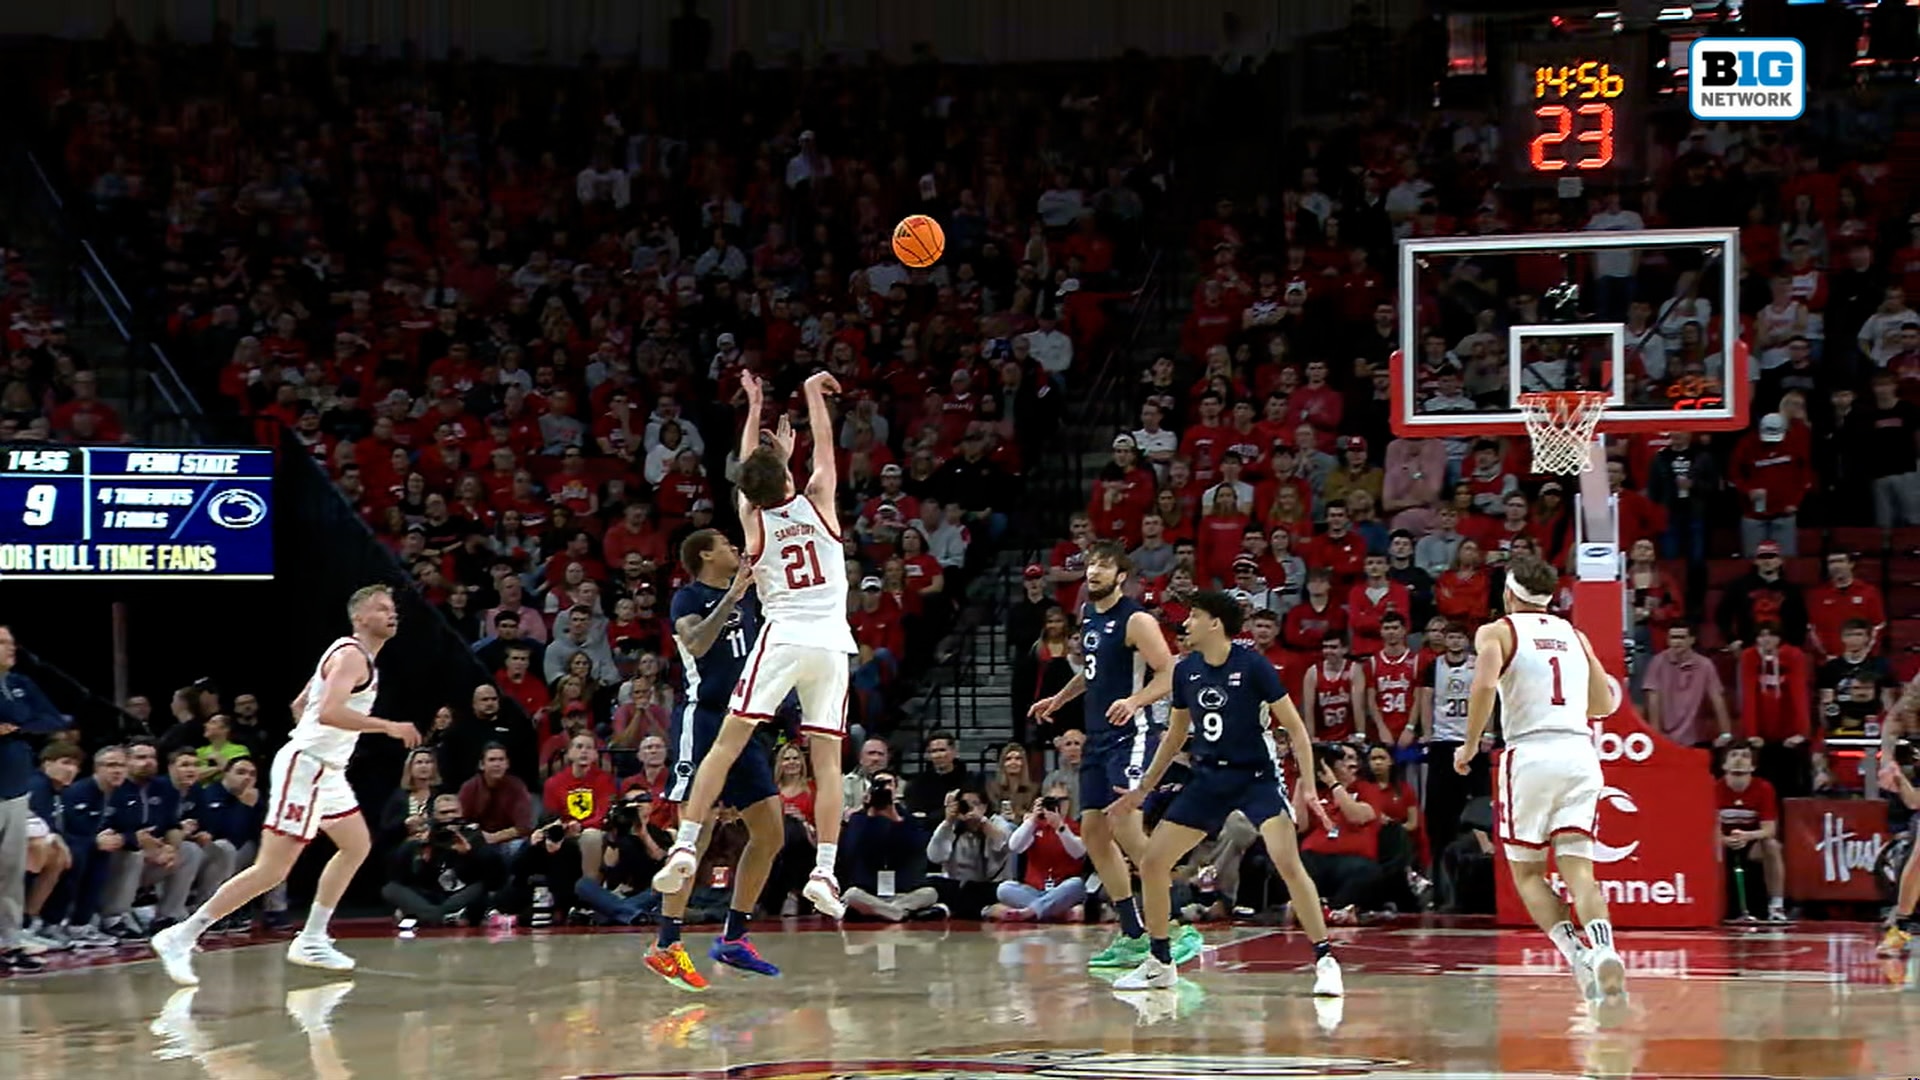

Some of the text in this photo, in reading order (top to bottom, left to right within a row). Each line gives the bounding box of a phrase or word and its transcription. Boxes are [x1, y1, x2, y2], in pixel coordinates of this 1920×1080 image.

[1534, 61, 1625, 99] 14:56
[1529, 103, 1616, 171] 23
[126, 452, 240, 474] PENN STATE
[22, 484, 58, 527] 9
[97, 487, 114, 505] 4
[103, 511, 115, 528] 1
[35, 544, 95, 571] FULL
[95, 544, 155, 571] TIME
[157, 545, 217, 571] FANS
[780, 540, 826, 590] 21
[726, 628, 747, 659] 11
[1084, 653, 1098, 680] 3
[1548, 655, 1567, 706] 1
[1381, 692, 1407, 713] 34
[1202, 711, 1224, 742] 9
[284, 803, 305, 822] N
